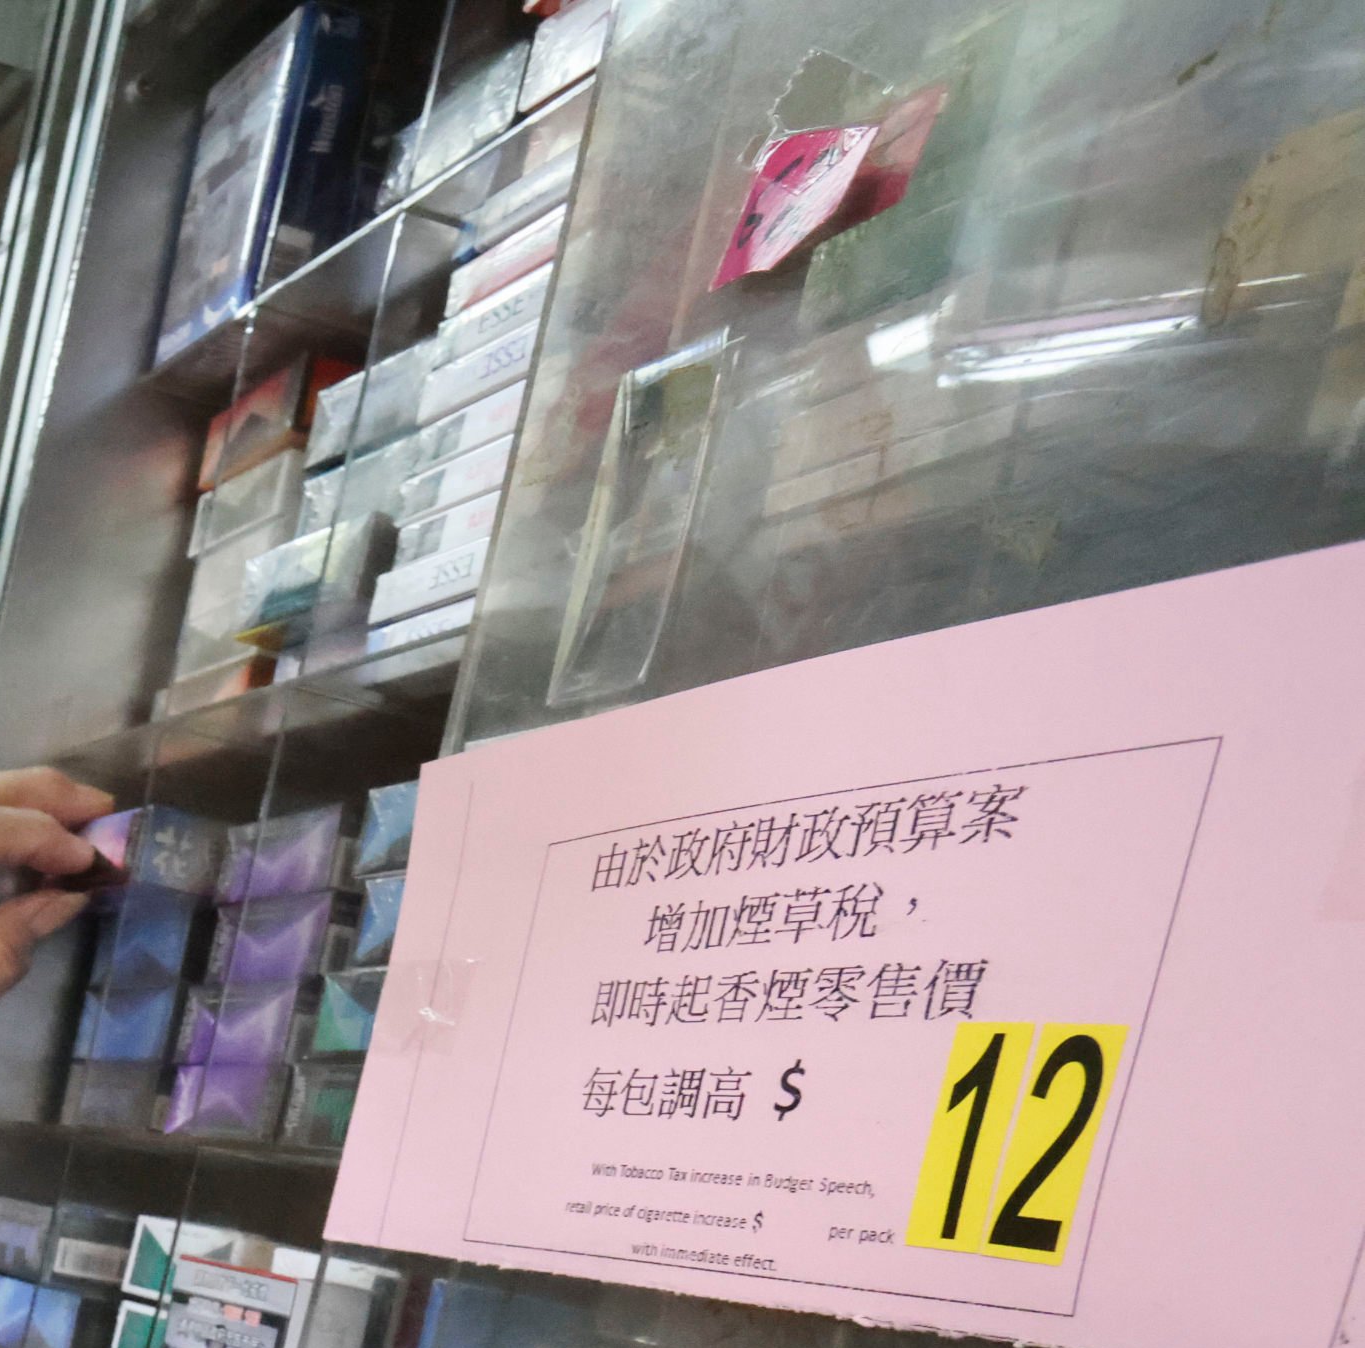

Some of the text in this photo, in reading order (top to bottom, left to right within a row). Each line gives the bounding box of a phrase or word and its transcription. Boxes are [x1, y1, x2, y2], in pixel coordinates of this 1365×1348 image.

[589, 785, 1029, 892] 由於政府財政預算案
[588, 957, 989, 1028] 即時起香煙零售價
[579, 1065, 752, 1122] 每包調高
[938, 1030, 1104, 1255] 12
[591, 1162, 876, 1199] With Tobacco Tax increase in Budget Speech,
[565, 1200, 593, 1215] retail
[593, 1203, 620, 1218] price
[623, 1205, 635, 1219] of
[636, 1206, 690, 1225] cigarette
[692, 1210, 747, 1230] increase
[828, 1224, 853, 1241] per
[859, 1227, 896, 1245] pack
[631, 1241, 778, 1271] with immediate effect.
